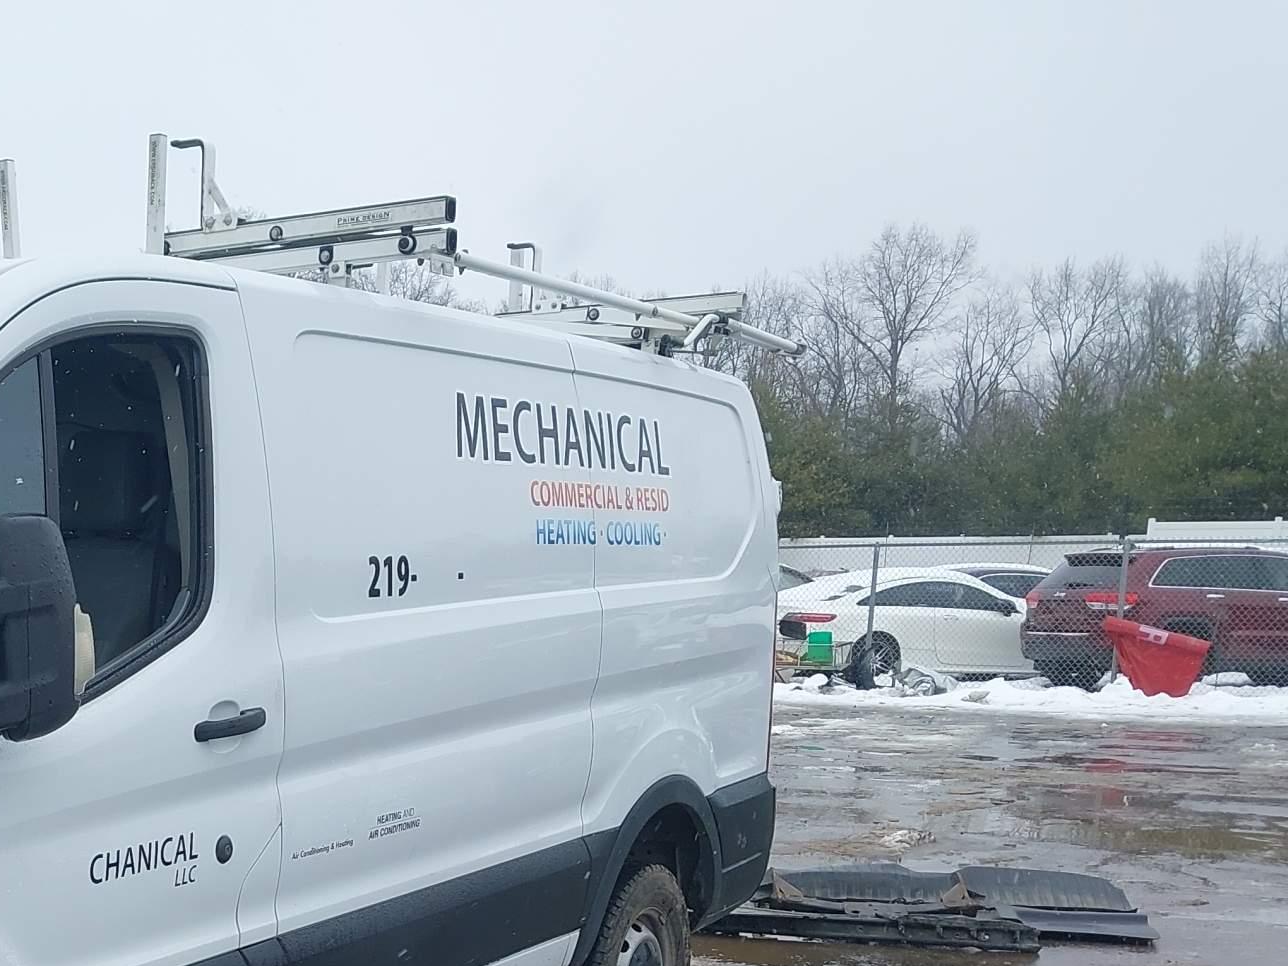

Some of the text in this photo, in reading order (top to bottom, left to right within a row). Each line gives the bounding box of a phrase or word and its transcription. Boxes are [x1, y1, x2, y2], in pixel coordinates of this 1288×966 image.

[456, 391, 671, 476] MECHANICAL
[530, 480, 670, 512] COMMERCIAL & RESID
[536, 520, 662, 546] HEATING COOLING
[368, 555, 418, 598] 219-
[368, 819, 421, 840] AIR CONDITIONING
[376, 808, 415, 825] HEATING AND
[89, 831, 199, 885] CHANICAL
[291, 851, 300, 860] Air
[300, 844, 330, 858] Conditioning
[335, 838, 354, 849] Heating
[174, 864, 197, 888] LLC
